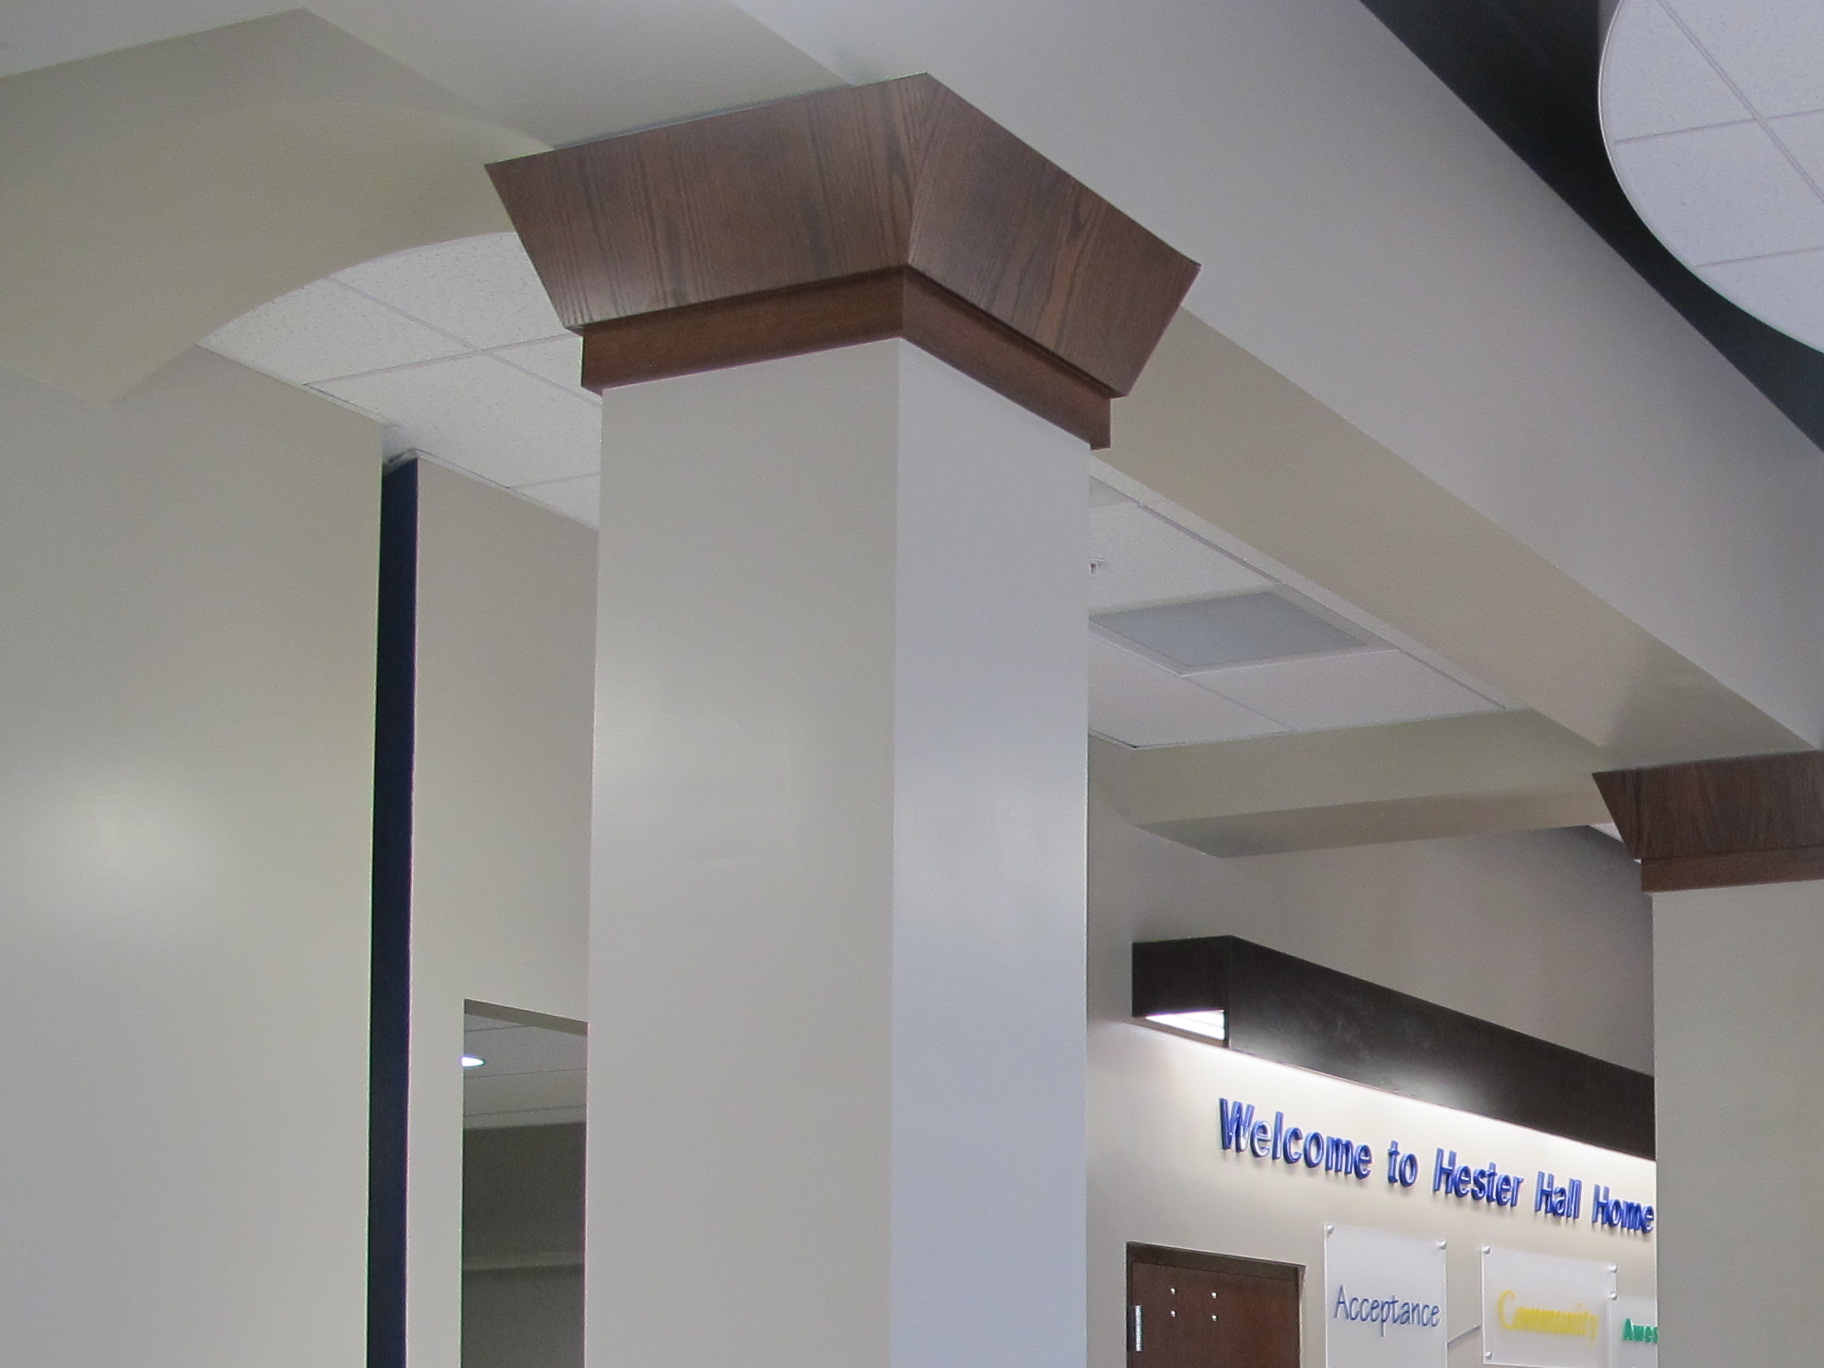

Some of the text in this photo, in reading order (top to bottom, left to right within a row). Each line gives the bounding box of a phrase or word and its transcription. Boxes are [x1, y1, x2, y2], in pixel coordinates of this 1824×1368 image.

[1219, 1097, 1655, 1233] Welcome to Hester Hall Home
[1334, 1285, 1440, 1337] Acceptance
